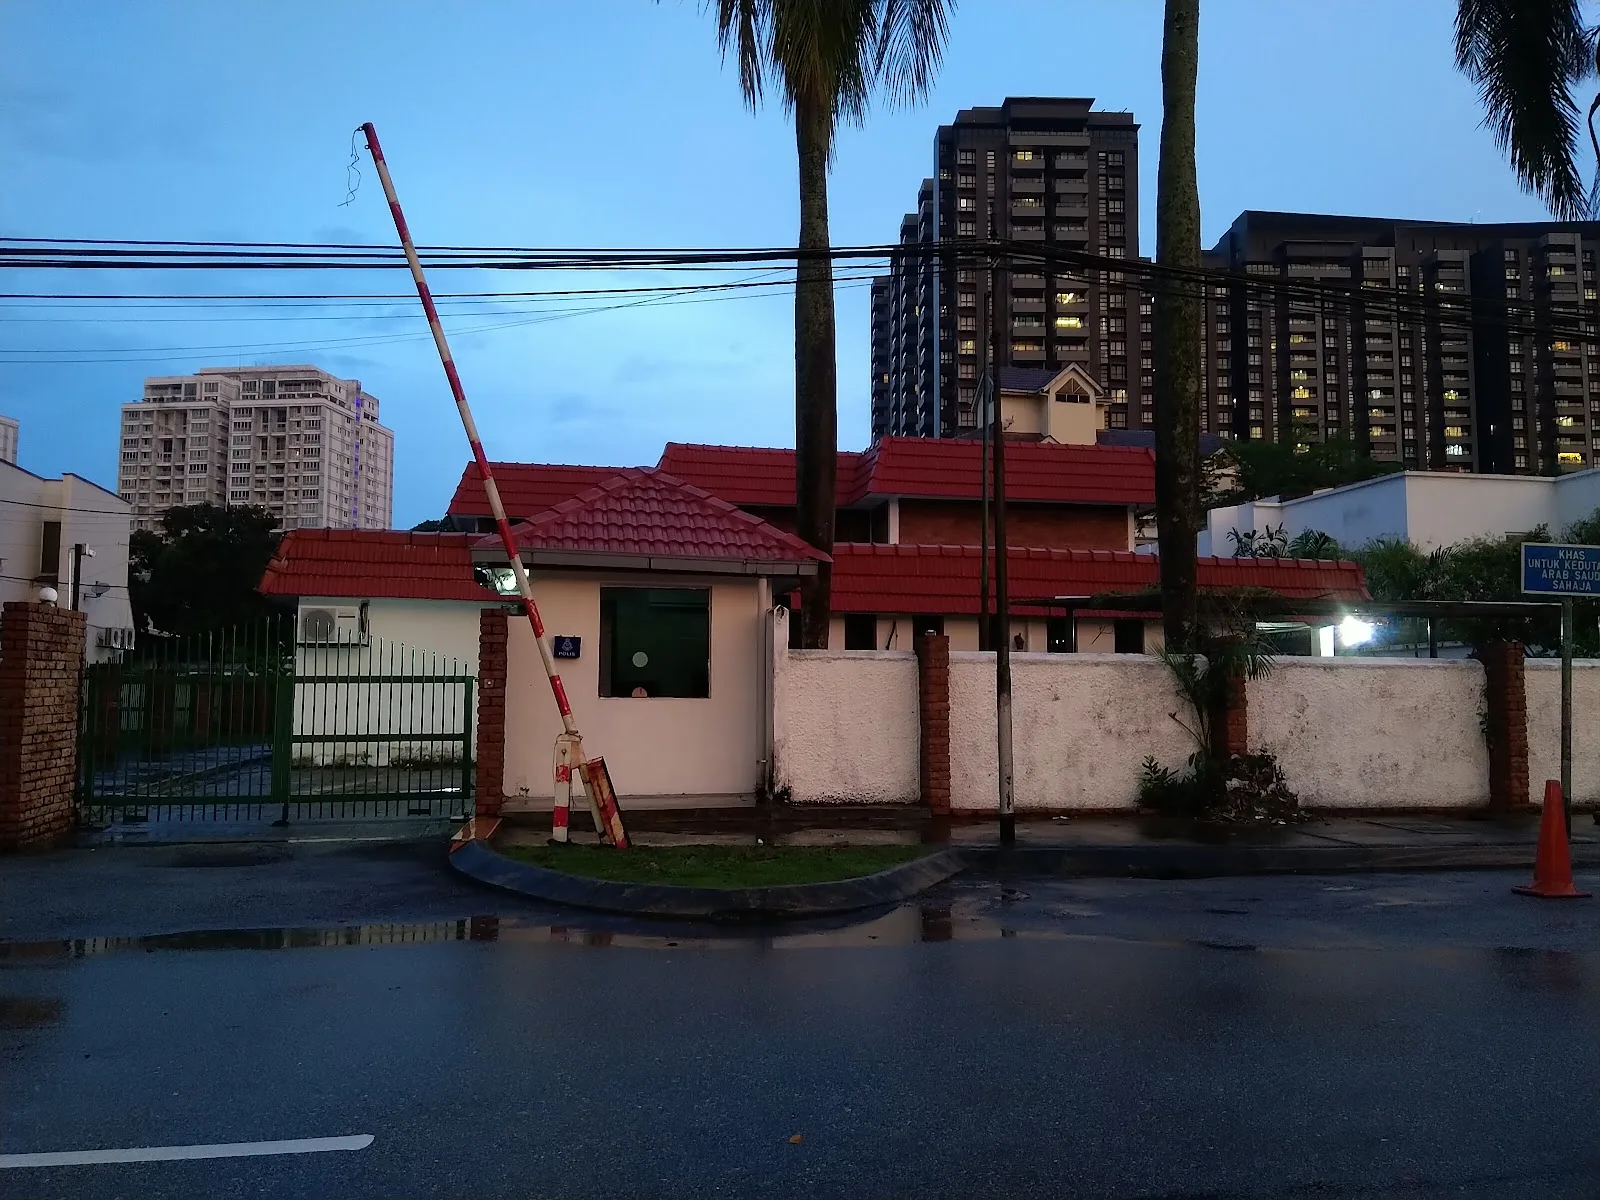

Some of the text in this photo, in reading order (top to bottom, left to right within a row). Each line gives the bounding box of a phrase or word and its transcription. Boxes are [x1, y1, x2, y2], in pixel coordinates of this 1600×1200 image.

[1559, 550, 1585, 560] KHAS
[1528, 559, 1560, 569] UNTUK
[1541, 569, 1569, 579] ARAB
[1552, 580, 1592, 591] SAHAJA
